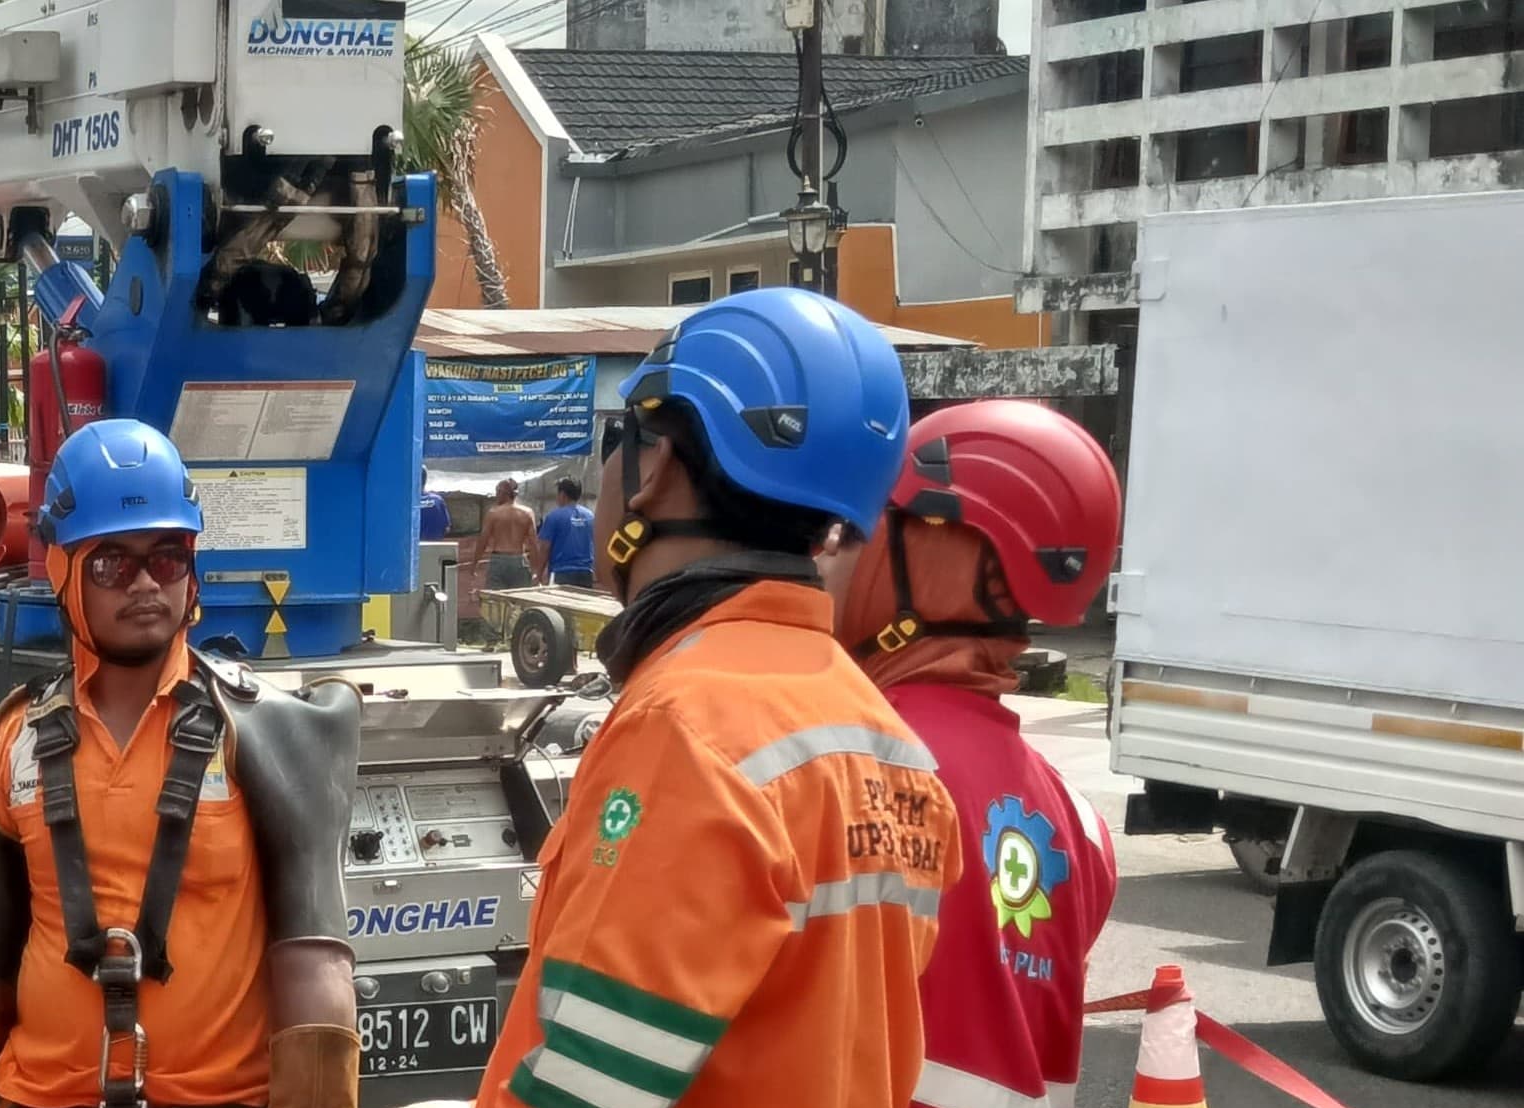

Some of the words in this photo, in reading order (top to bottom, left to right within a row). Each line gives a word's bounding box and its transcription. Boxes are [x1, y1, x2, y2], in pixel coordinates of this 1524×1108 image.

[247, 18, 397, 47] DONGHAE
[247, 46, 322, 56] MACHINERY
[327, 47, 335, 56] &
[337, 48, 393, 57] AVIATION
[52, 118, 82, 158] DHT
[85, 110, 120, 152] 150S
[348, 897, 499, 937] ONGHAE
[1014, 951, 1053, 981] PLN
[358, 1007, 430, 1052] 8512
[451, 1003, 489, 1045] CW
